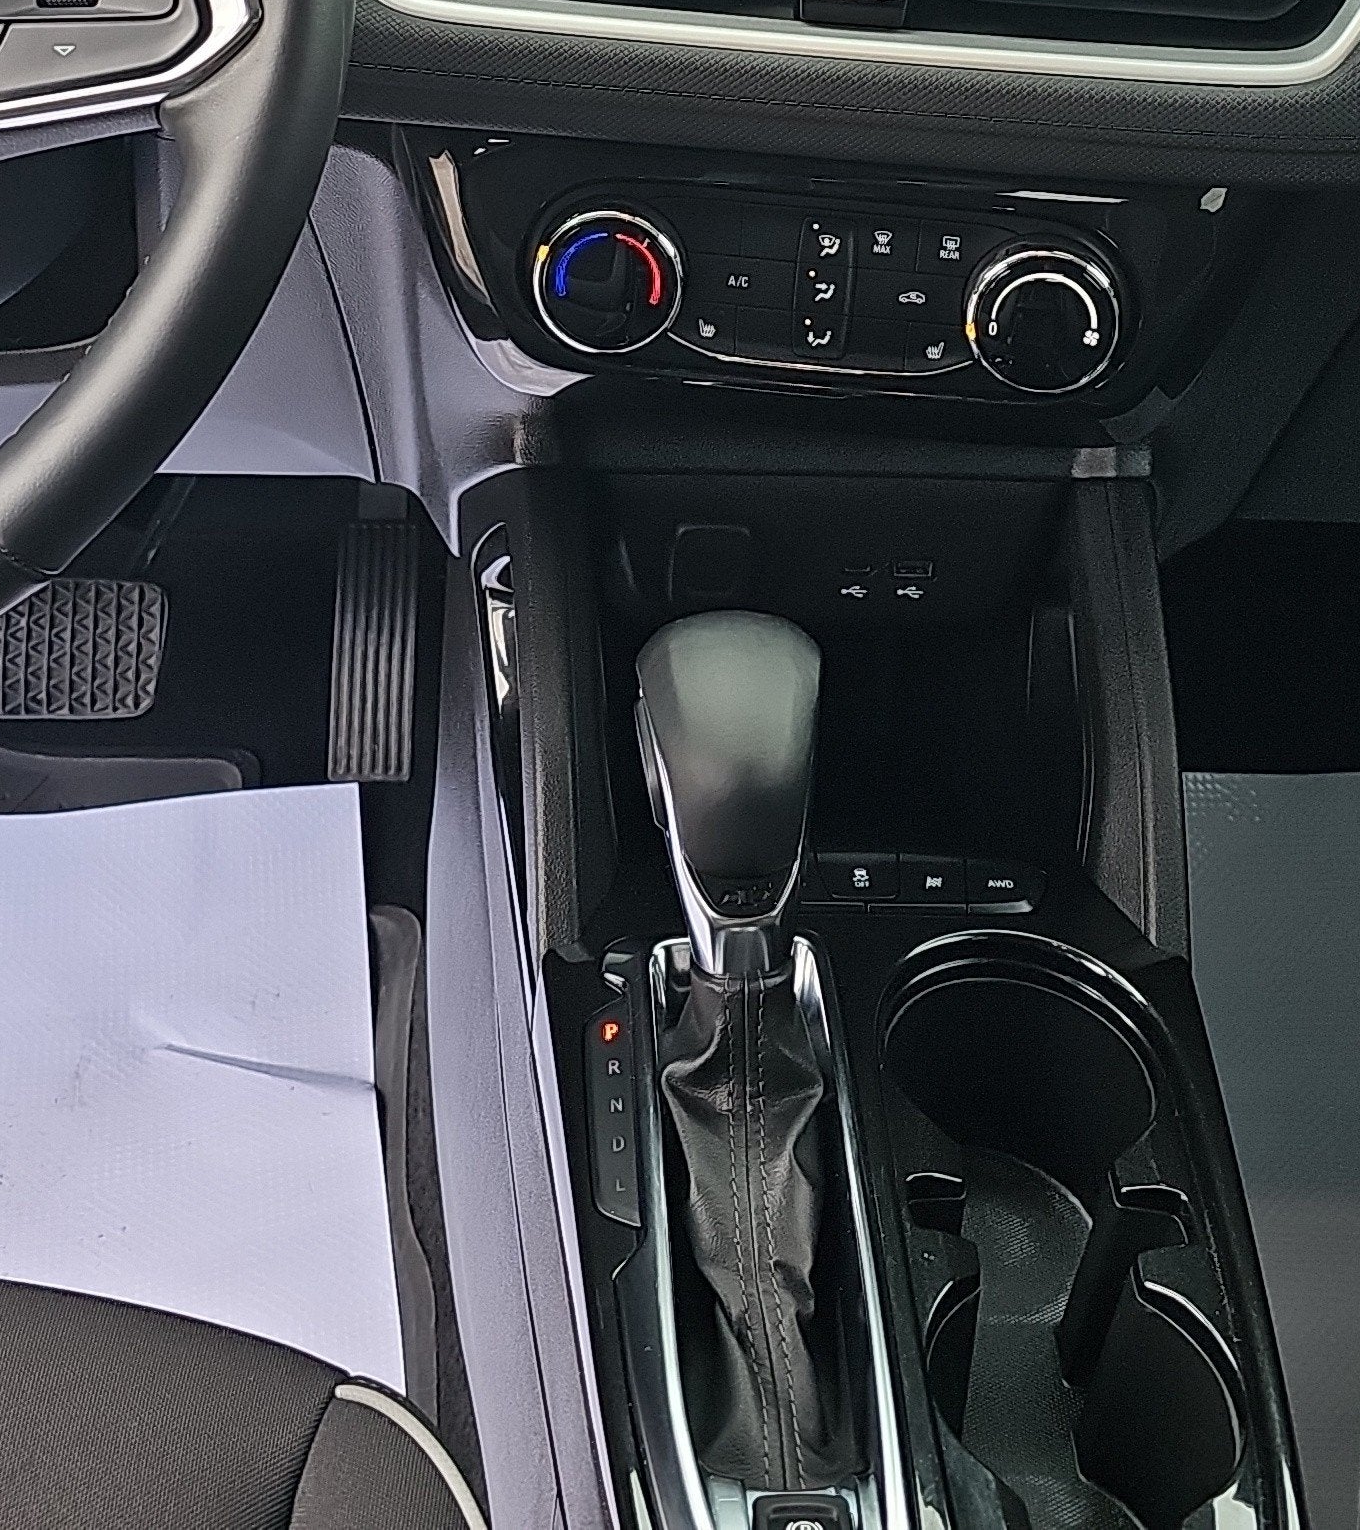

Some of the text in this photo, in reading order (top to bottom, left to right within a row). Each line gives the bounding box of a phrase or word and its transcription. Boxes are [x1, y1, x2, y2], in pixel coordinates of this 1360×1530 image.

[872, 244, 891, 255] MAX
[939, 249, 960, 260] REAR
[728, 275, 749, 288] A/C
[988, 321, 997, 336] 0
[988, 879, 1014, 889] AWD
[603, 1023, 619, 1042] P
[608, 1060, 621, 1075] R
[610, 1097, 623, 1113] N
[612, 1136, 625, 1153] D
[615, 1179, 626, 1192] L
